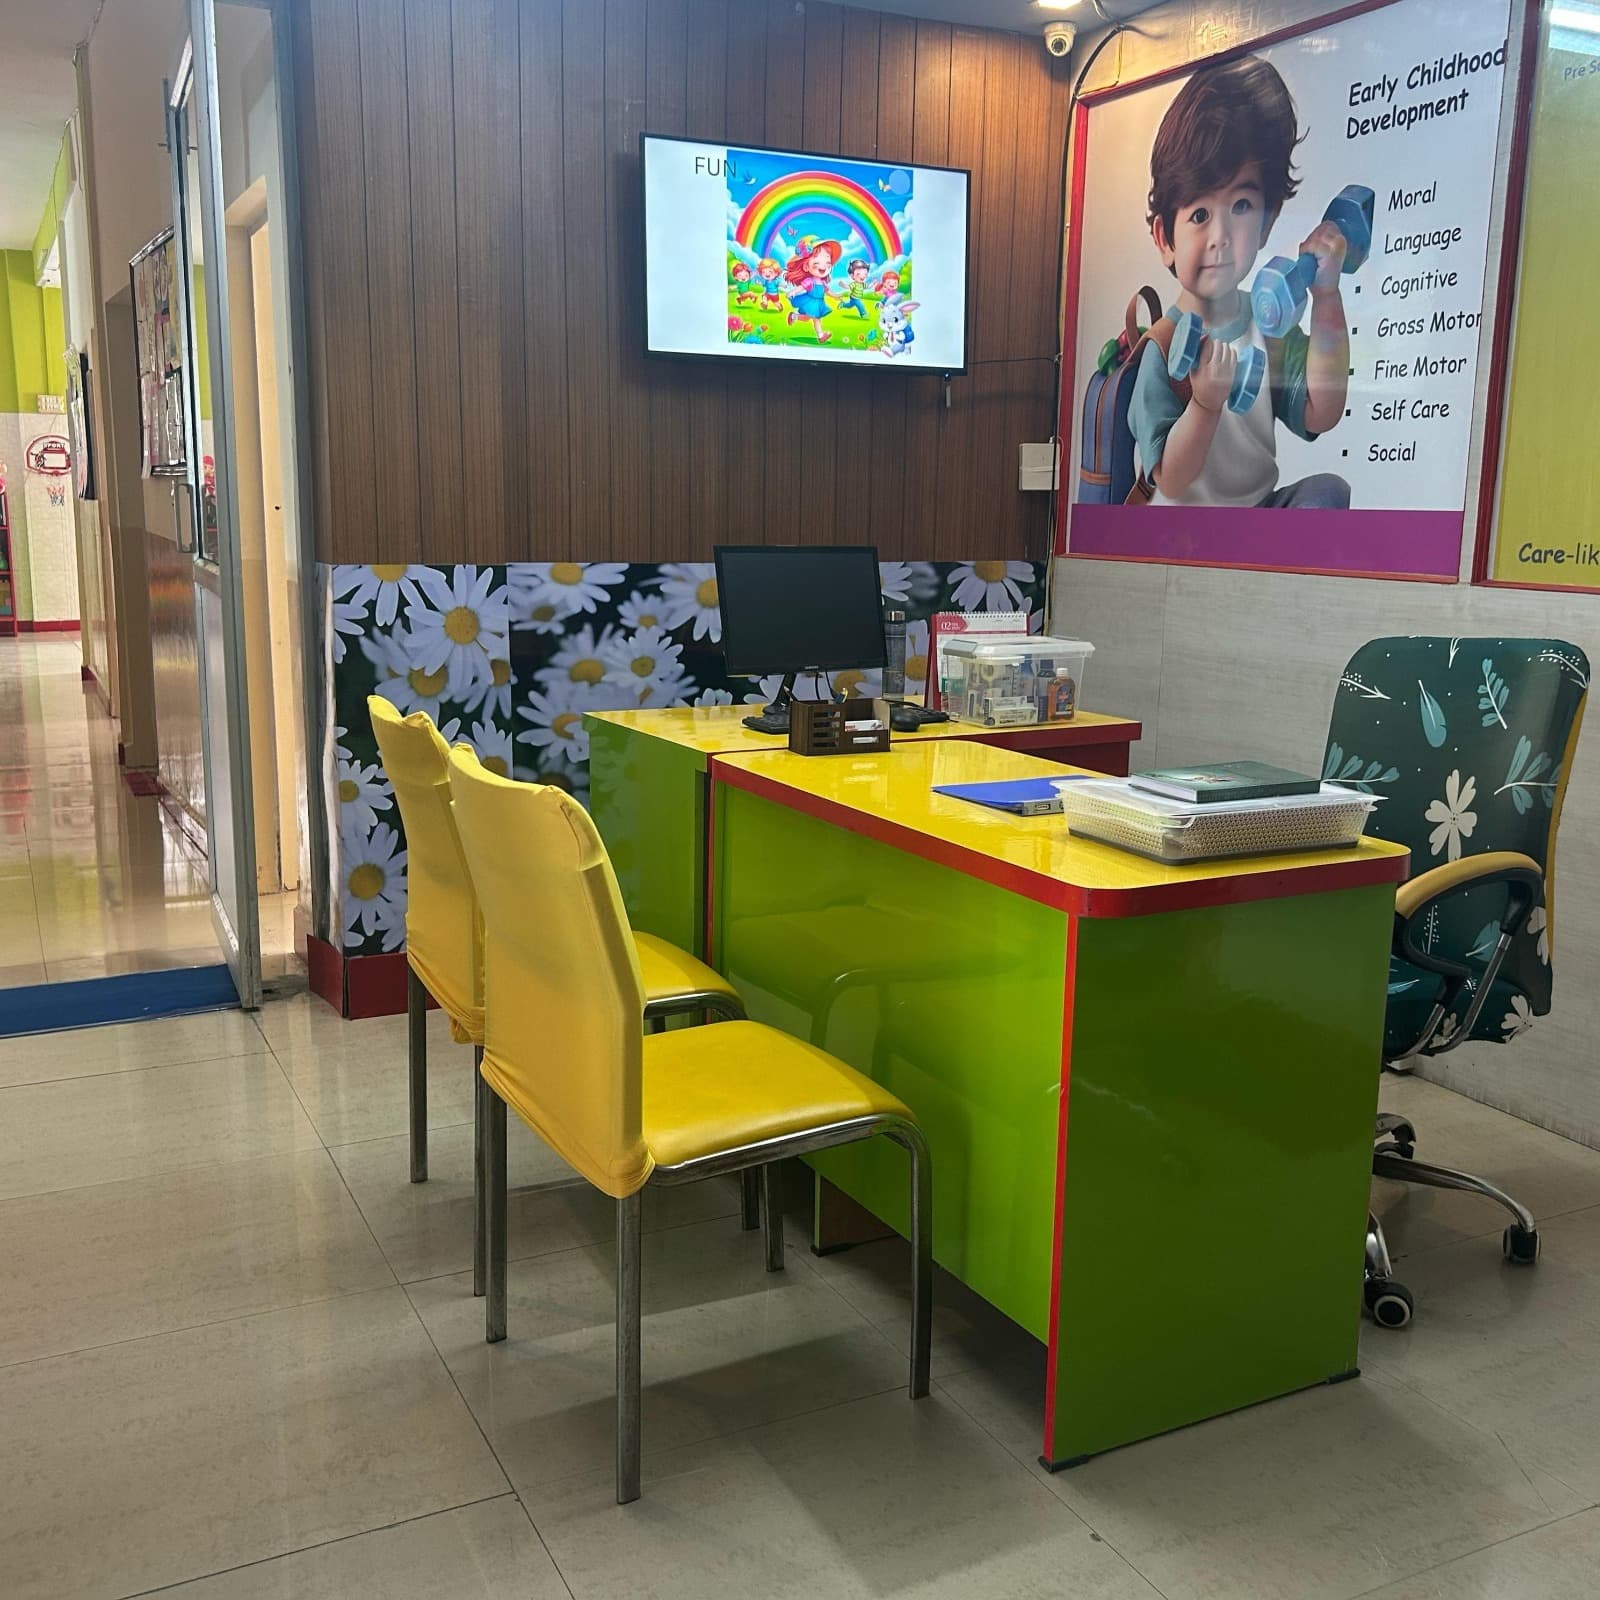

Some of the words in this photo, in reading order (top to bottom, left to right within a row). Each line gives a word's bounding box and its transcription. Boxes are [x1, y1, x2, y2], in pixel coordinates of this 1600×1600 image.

[1349, 74, 1398, 107] Early
[1406, 38, 1508, 90] Childhood
[1564, 64, 1586, 81] Pre
[1346, 88, 1469, 139] Development
[695, 156, 737, 178] FUN
[1388, 181, 1437, 212] Moral
[1384, 227, 1462, 255] Language
[1381, 269, 1458, 299] Cognitive
[1377, 316, 1424, 338] Gross
[1430, 311, 1482, 334] Motor
[1374, 359, 1408, 380] Fine
[1413, 356, 1467, 377] Motor
[1371, 400, 1406, 421] Self
[1411, 400, 1450, 419] Care
[1368, 440, 1416, 462] Social
[1518, 542, 1600, 566] Care-lik
